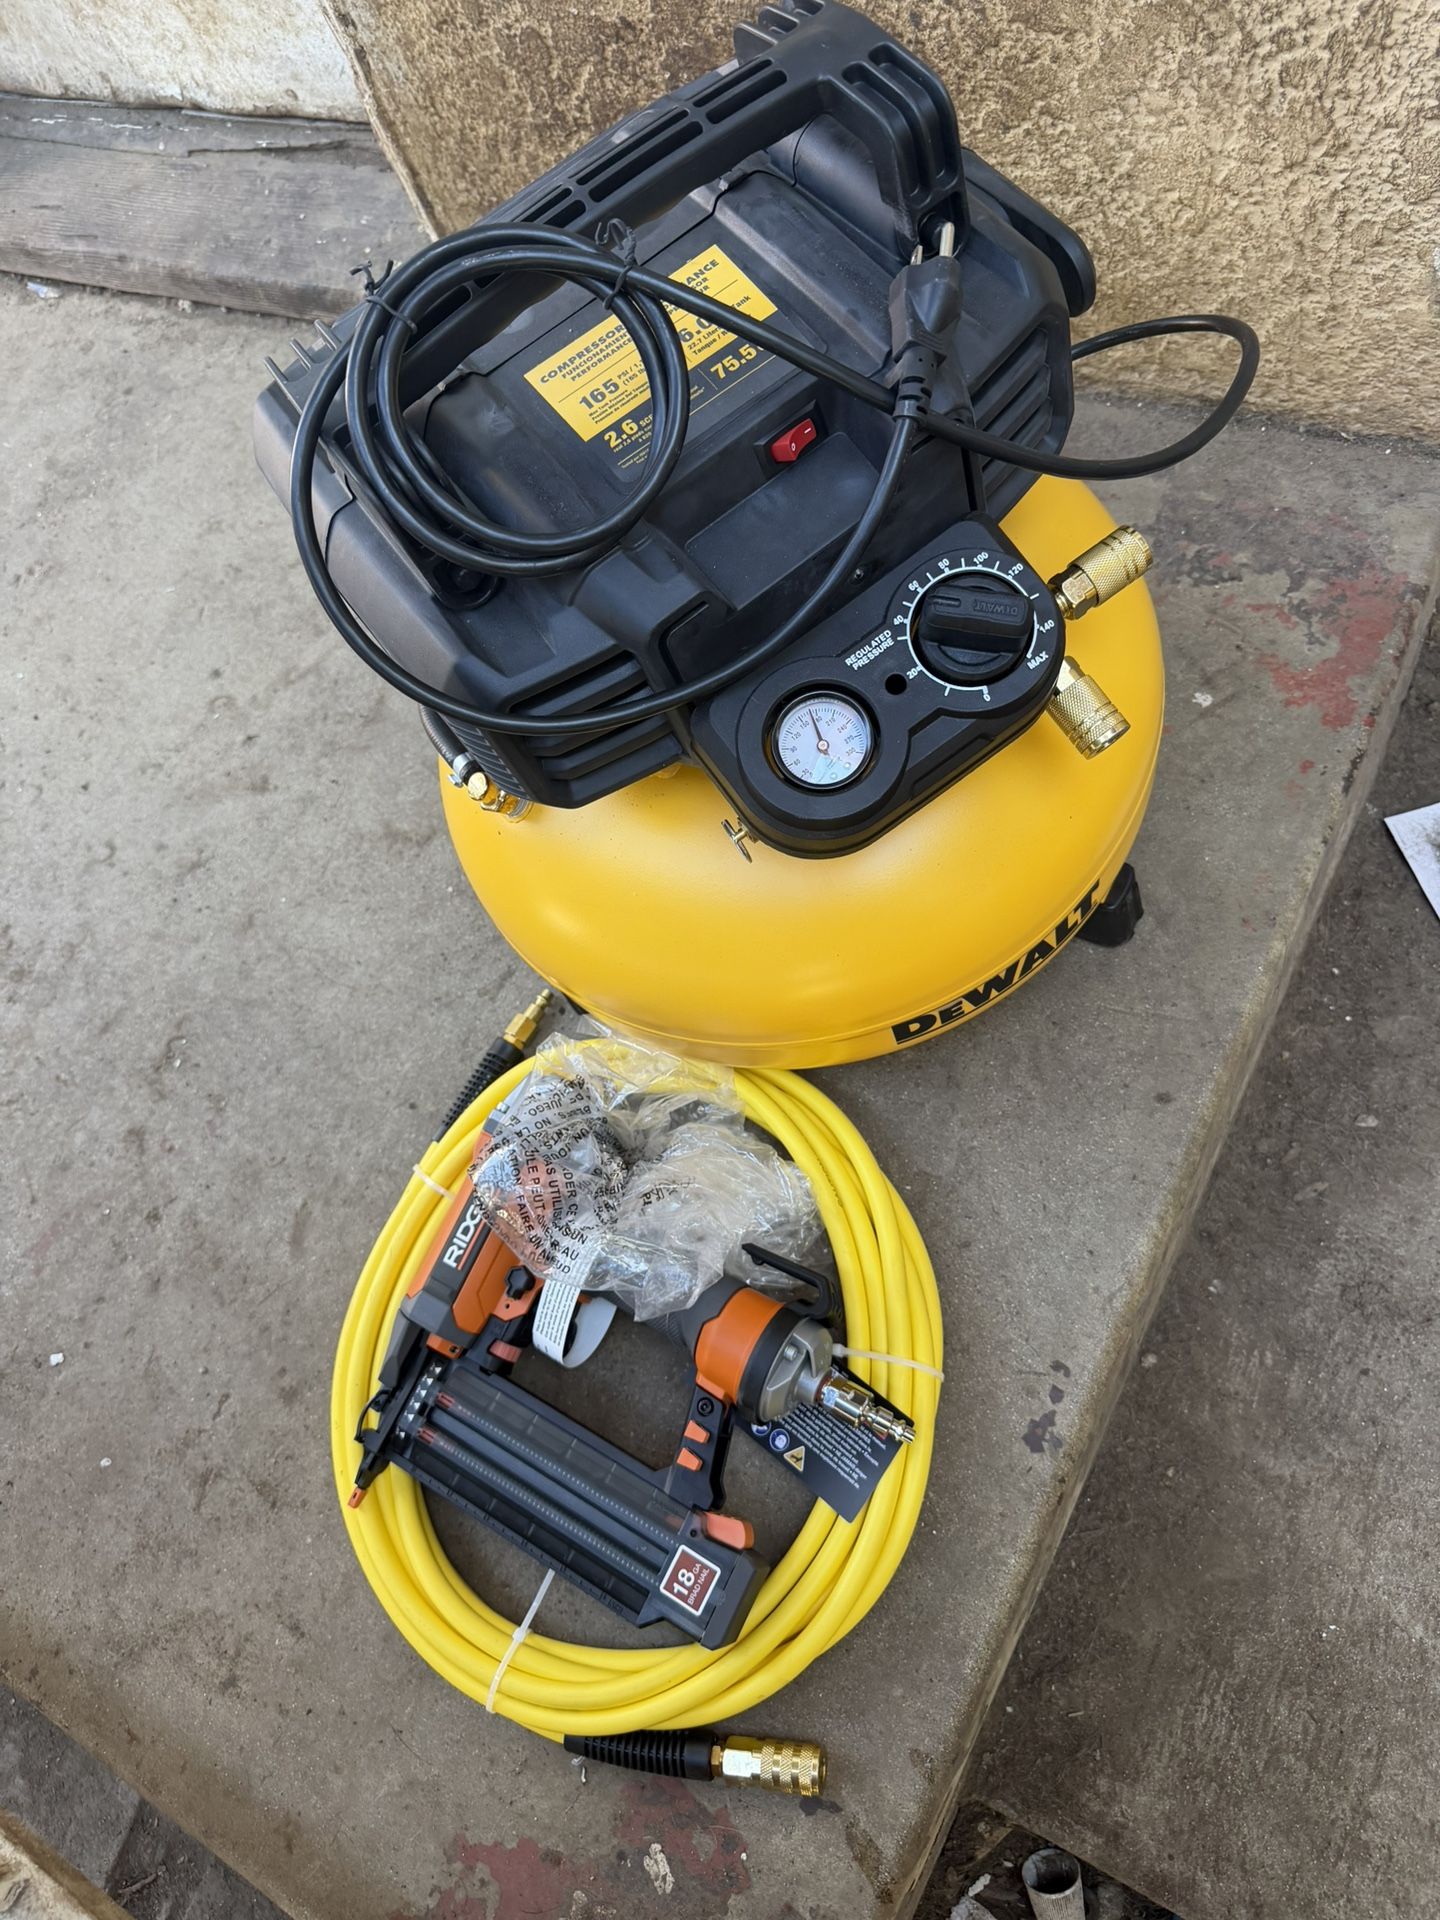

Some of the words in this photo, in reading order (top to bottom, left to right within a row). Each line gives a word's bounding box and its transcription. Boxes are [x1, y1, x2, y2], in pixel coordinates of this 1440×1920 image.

[538, 323, 626, 384] COMPRESSOR
[560, 331, 630, 379] FUNCIONAMIEN
[691, 336, 718, 356] Tanque
[709, 342, 758, 382] 75.5
[577, 376, 621, 412] 165
[601, 416, 640, 449] 2.6
[938, 559, 950, 569] 80
[973, 552, 989, 566] 100
[1008, 563, 1024, 577] 120
[908, 580, 919, 592] 60
[893, 615, 904, 626] 40
[1039, 619, 1055, 634] 140
[845, 629, 892, 667] REGULATED
[852, 638, 894, 671] PRESSURE
[1027, 651, 1049, 670] MAX
[907, 668, 917, 680] 20
[891, 879, 1100, 1044] DEWALT
[524, 1100, 563, 1116] JUEGO.
[535, 1117, 550, 1128] NO
[516, 1194, 535, 1233] FAIRE
[531, 1177, 546, 1211] PEUT
[561, 1246, 580, 1261] AU
[672, 1567, 695, 1596] 18
[692, 1563, 702, 1575] GA
[687, 1583, 701, 1606] BRAD
[698, 1567, 710, 1585] NAIL
